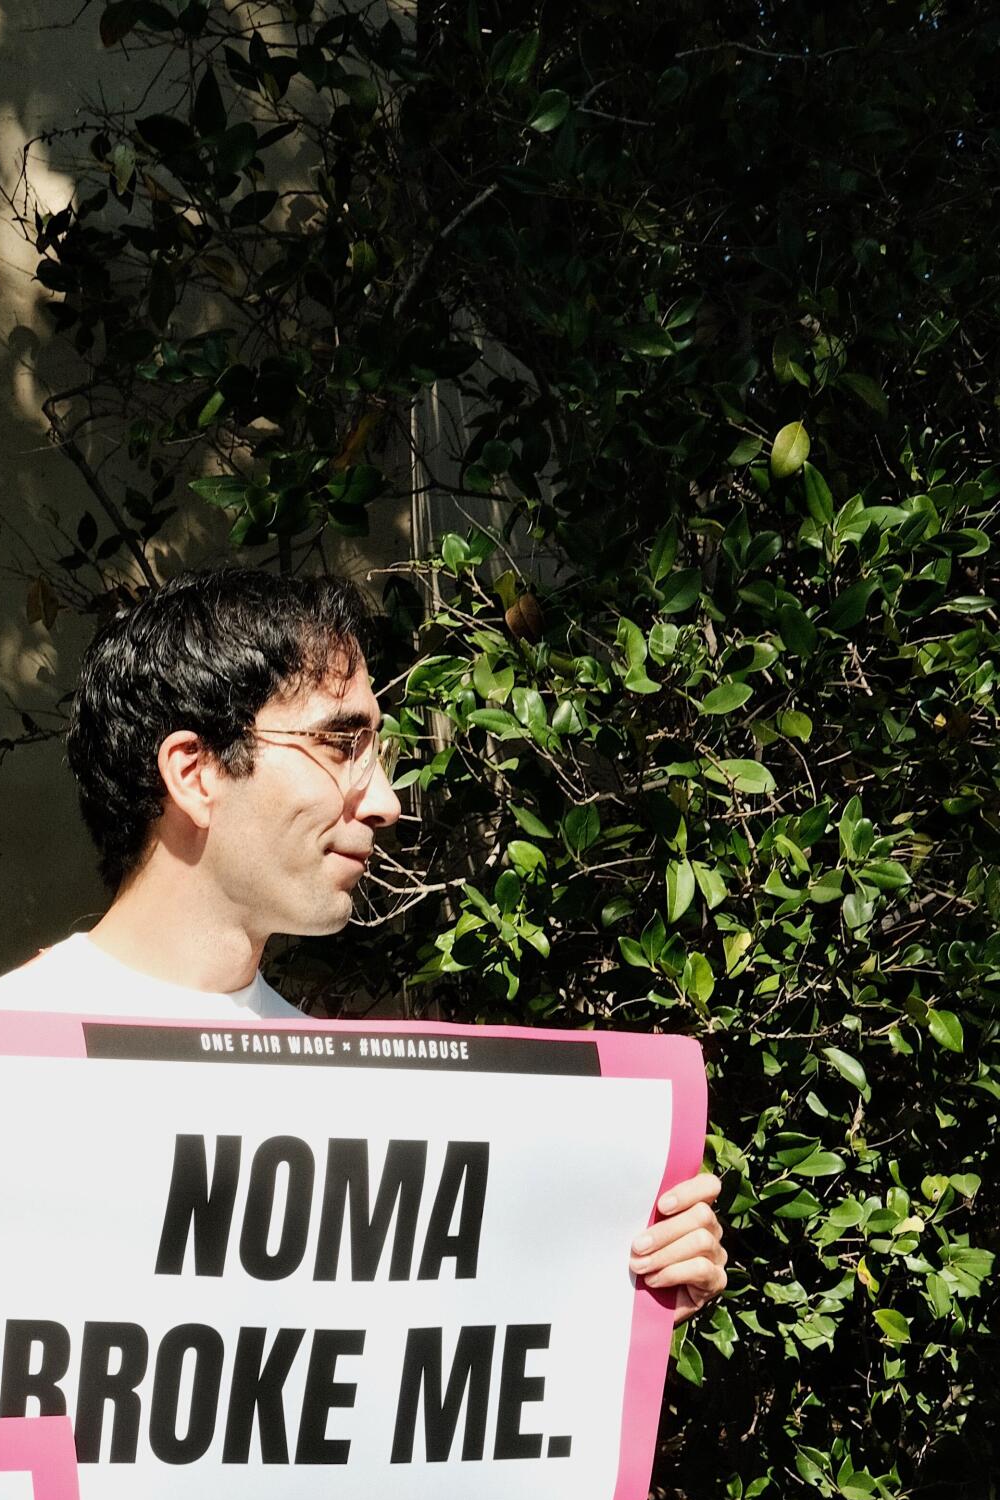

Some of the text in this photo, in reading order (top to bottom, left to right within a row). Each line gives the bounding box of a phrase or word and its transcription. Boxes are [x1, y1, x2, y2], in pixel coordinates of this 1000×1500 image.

[200, 1033, 234, 1052] ONE
[241, 1034, 281, 1053] FAIR
[287, 1036, 335, 1055] WAGE
[359, 1038, 469, 1060] #NOMAABUSE
[155, 1134, 490, 1281] NOMA
[391, 1323, 571, 1464] ME.
